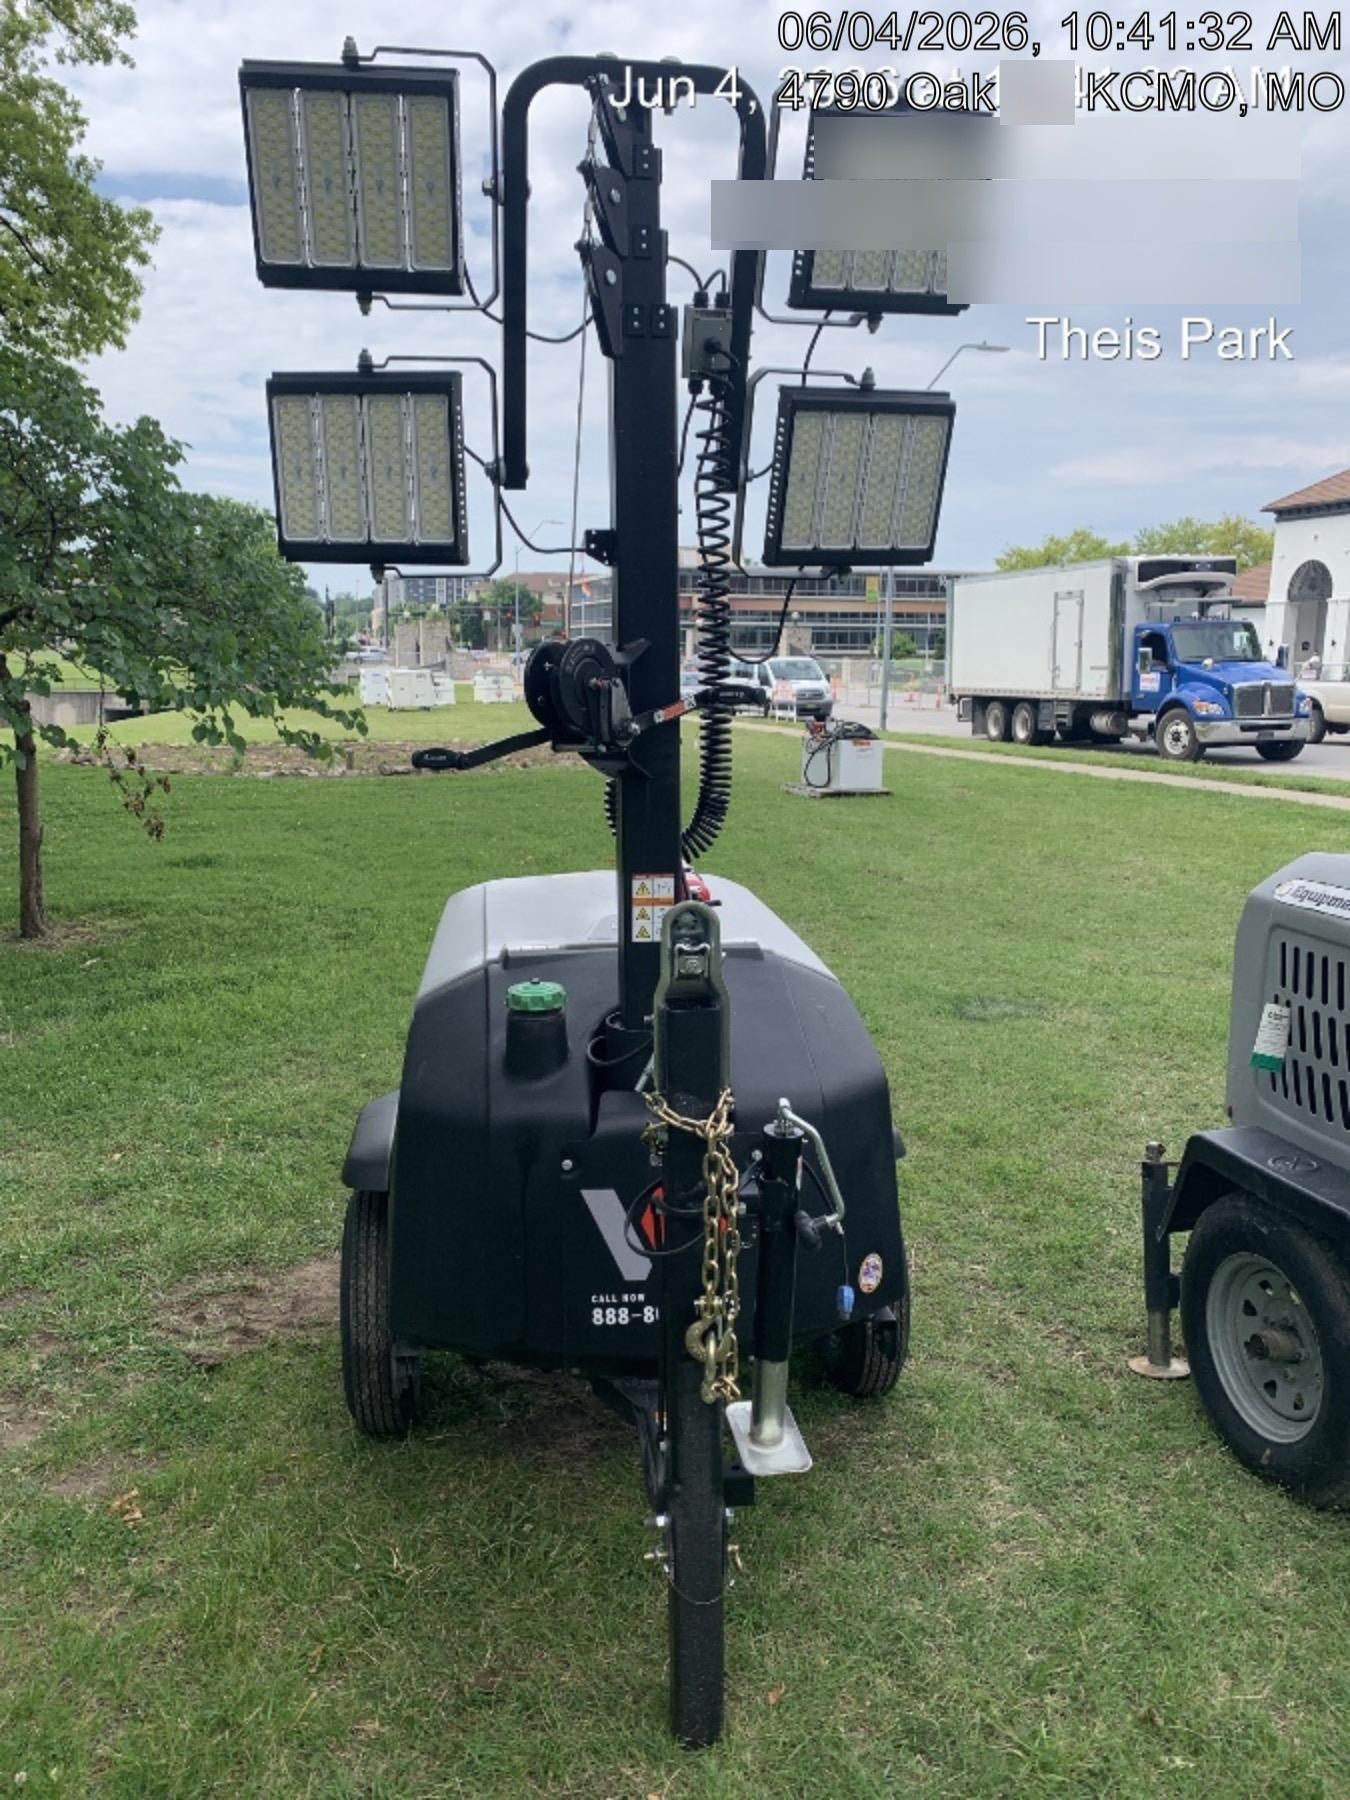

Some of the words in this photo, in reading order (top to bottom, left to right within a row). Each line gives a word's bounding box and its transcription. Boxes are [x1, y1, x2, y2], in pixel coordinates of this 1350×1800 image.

[591, 1293, 618, 1304] CALL
[621, 1292, 646, 1303] NOW
[592, 1305, 659, 1326] 888-8
